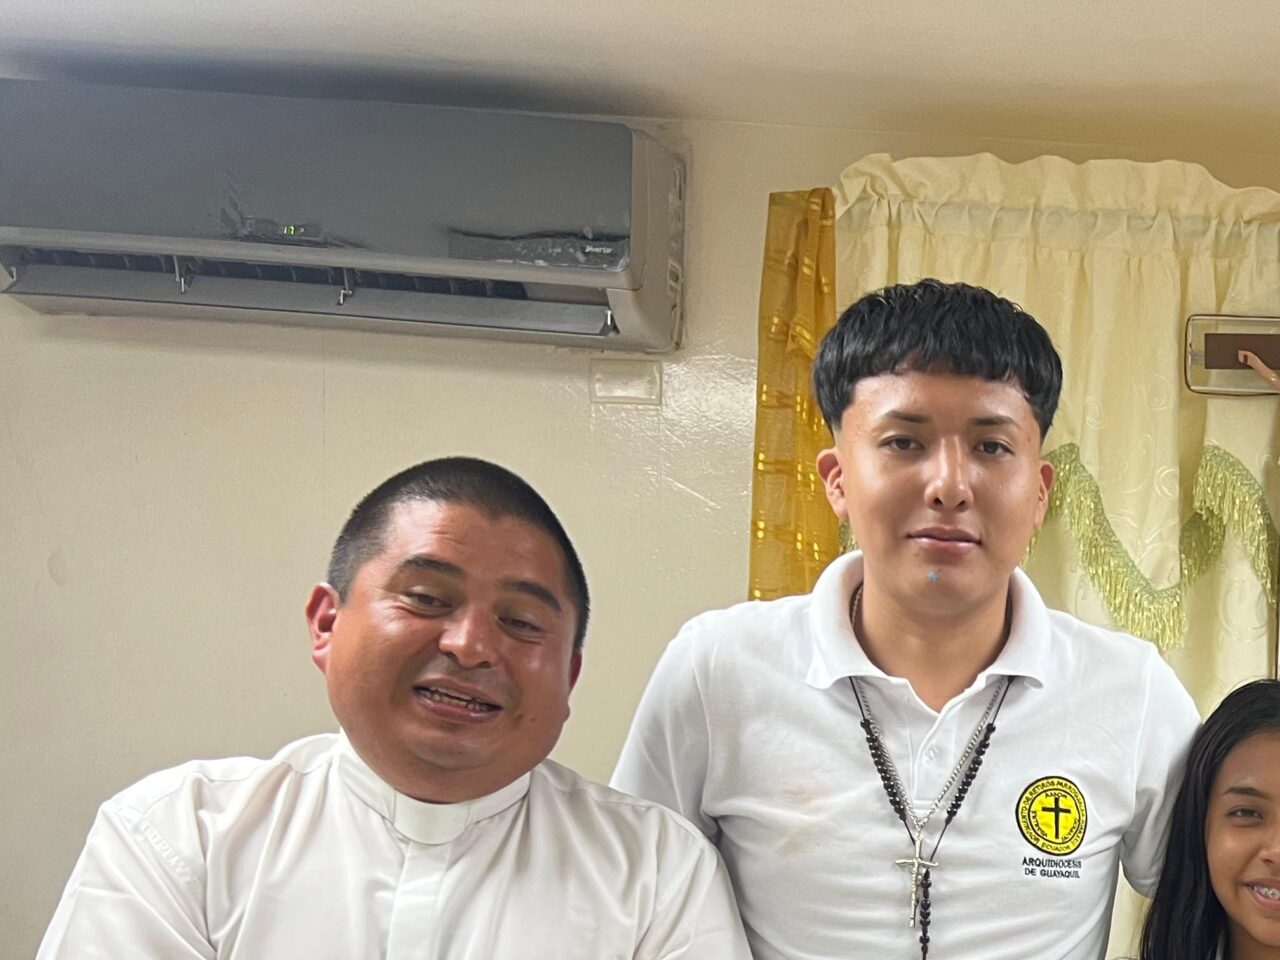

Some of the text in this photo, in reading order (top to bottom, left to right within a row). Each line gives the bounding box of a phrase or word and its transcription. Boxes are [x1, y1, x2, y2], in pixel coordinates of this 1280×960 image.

[1022, 857, 1082, 869] ARQUIDIOCESIS
[1024, 868, 1081, 878] DE GUAYAQUIL
